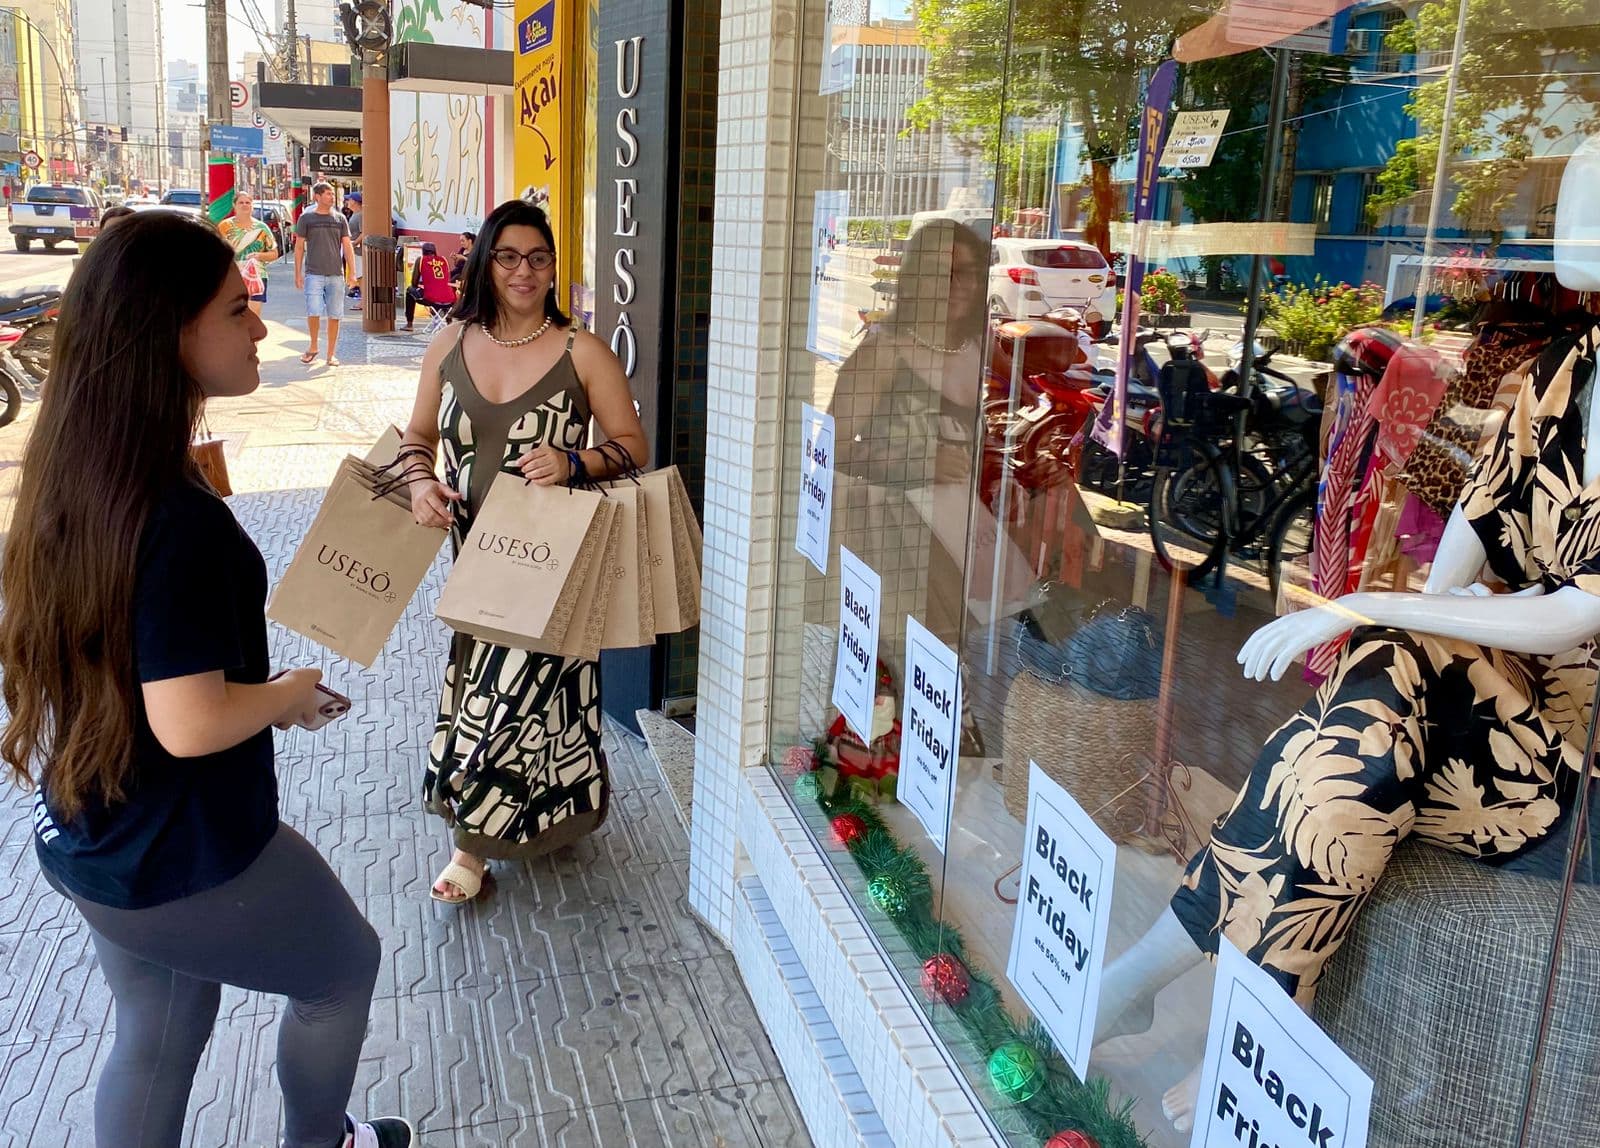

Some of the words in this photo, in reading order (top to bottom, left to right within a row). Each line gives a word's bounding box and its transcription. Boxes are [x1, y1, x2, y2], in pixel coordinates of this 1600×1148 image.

[230, 87, 240, 102] E
[520, 61, 557, 125] Açaí
[319, 154, 353, 167] CRIS
[611, 36, 644, 378] USESÔ
[806, 438, 827, 470] Black
[802, 473, 827, 510] Friday
[317, 544, 390, 593] USESÔ
[478, 532, 551, 563] USESÔ
[844, 586, 871, 630] Black
[842, 623, 870, 673] Friday
[913, 664, 952, 719] Black
[910, 707, 949, 770] Friday
[1035, 824, 1094, 913] Black
[1027, 874, 1090, 973] Friday
[1045, 948, 1060, 971] 50%
[1060, 967, 1071, 985] off
[1231, 1020, 1335, 1148] Black
